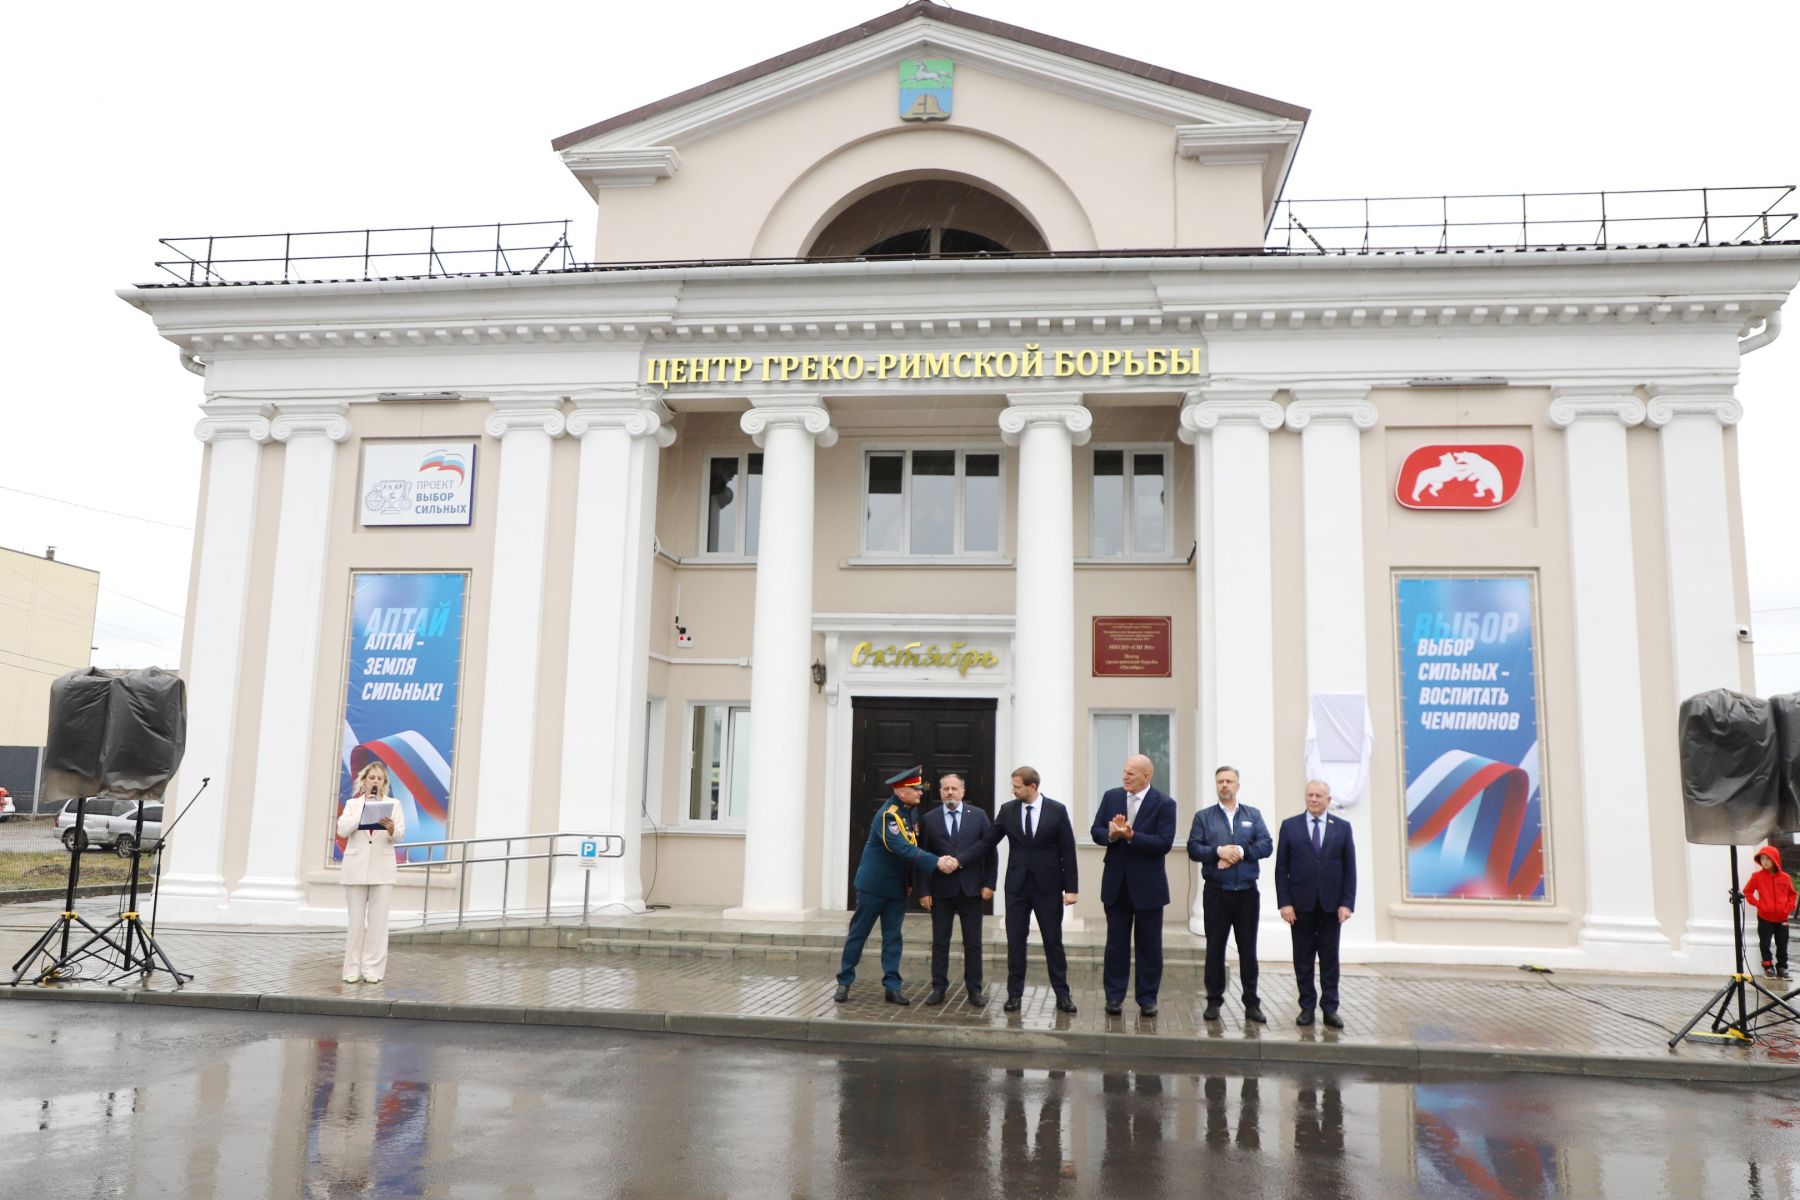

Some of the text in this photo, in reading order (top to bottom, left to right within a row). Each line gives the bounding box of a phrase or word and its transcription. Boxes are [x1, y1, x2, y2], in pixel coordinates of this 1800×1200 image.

[647, 343, 1201, 390] ЦЕНТР ГРЕКО-РИМСКОЙ БОРЬБЫ
[416, 480, 455, 490] ПРОЕКТ
[416, 492, 454, 502] ВЫБОР
[415, 504, 467, 514] СИЛЬНЫХ
[1413, 611, 1520, 643] ВЫБОР
[364, 629, 416, 651] АЛТАЙ
[1417, 638, 1475, 656] ВЫБОР
[363, 657, 417, 676] ЗЕМЛЯ
[851, 640, 998, 678] Октябрь
[1418, 662, 1499, 681] СИЛЬНЫХ
[362, 682, 444, 702] СИЛЬНЫХ!
[1419, 687, 1509, 705] ВОСПИТАТЬ
[1421, 711, 1520, 730] ЧЕМПИОНОВ
[584, 843, 594, 856] P
